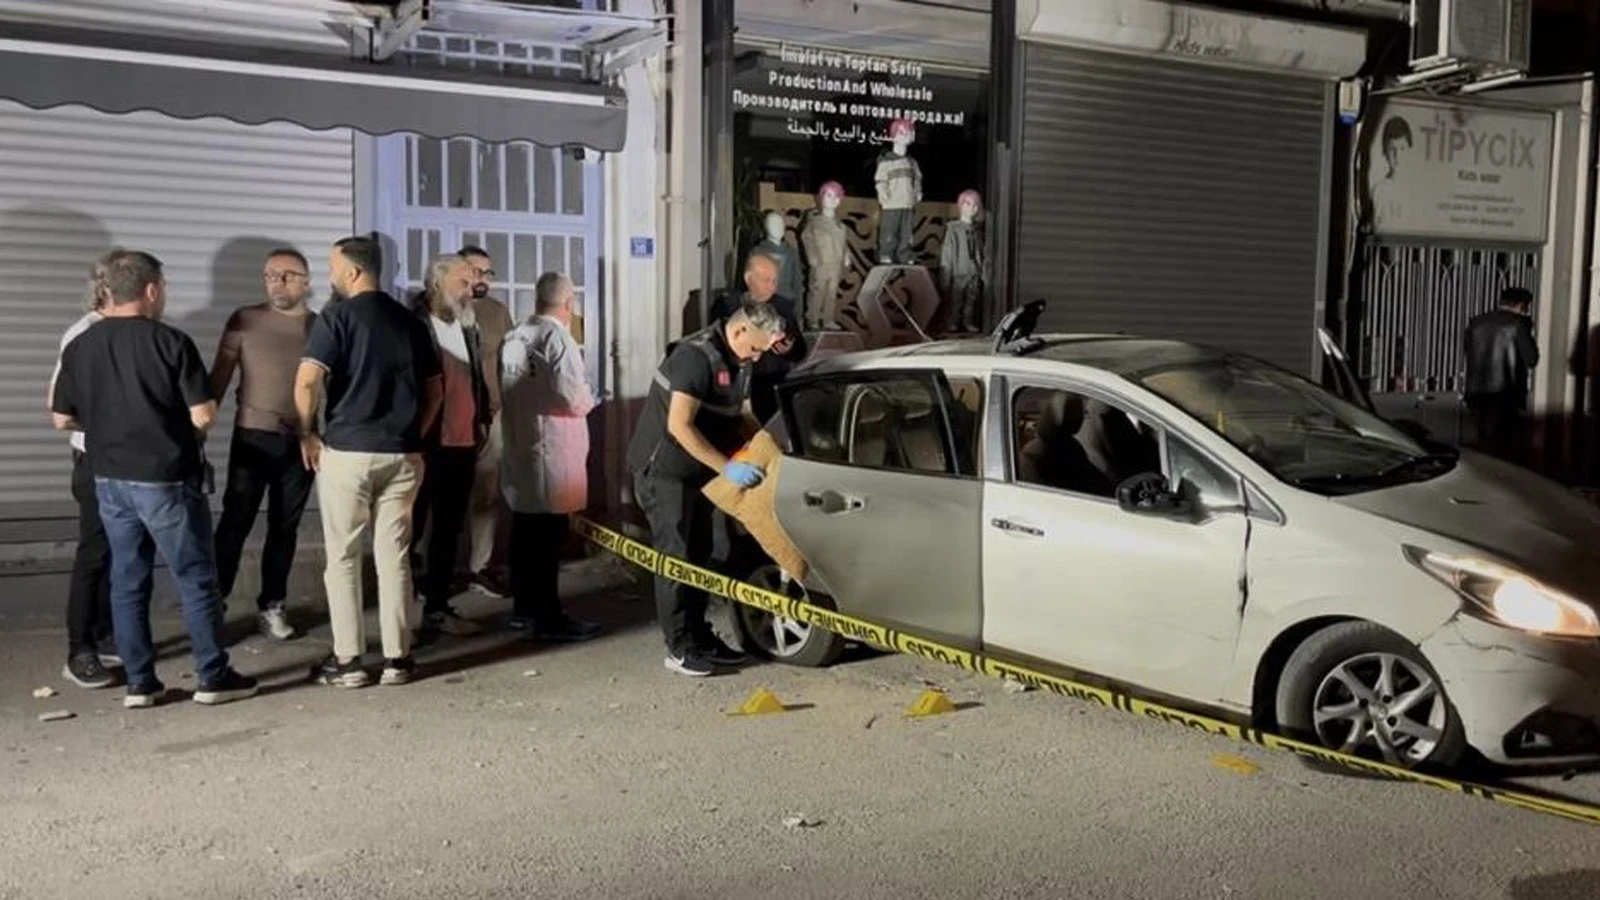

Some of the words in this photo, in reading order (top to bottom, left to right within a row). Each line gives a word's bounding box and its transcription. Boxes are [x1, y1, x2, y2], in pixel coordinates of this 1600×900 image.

[826, 56, 840, 68] ve
[845, 54, 888, 73] Toptan
[732, 89, 837, 115] Производитель
[839, 102, 847, 115] и
[869, 81, 933, 102] Wholesale
